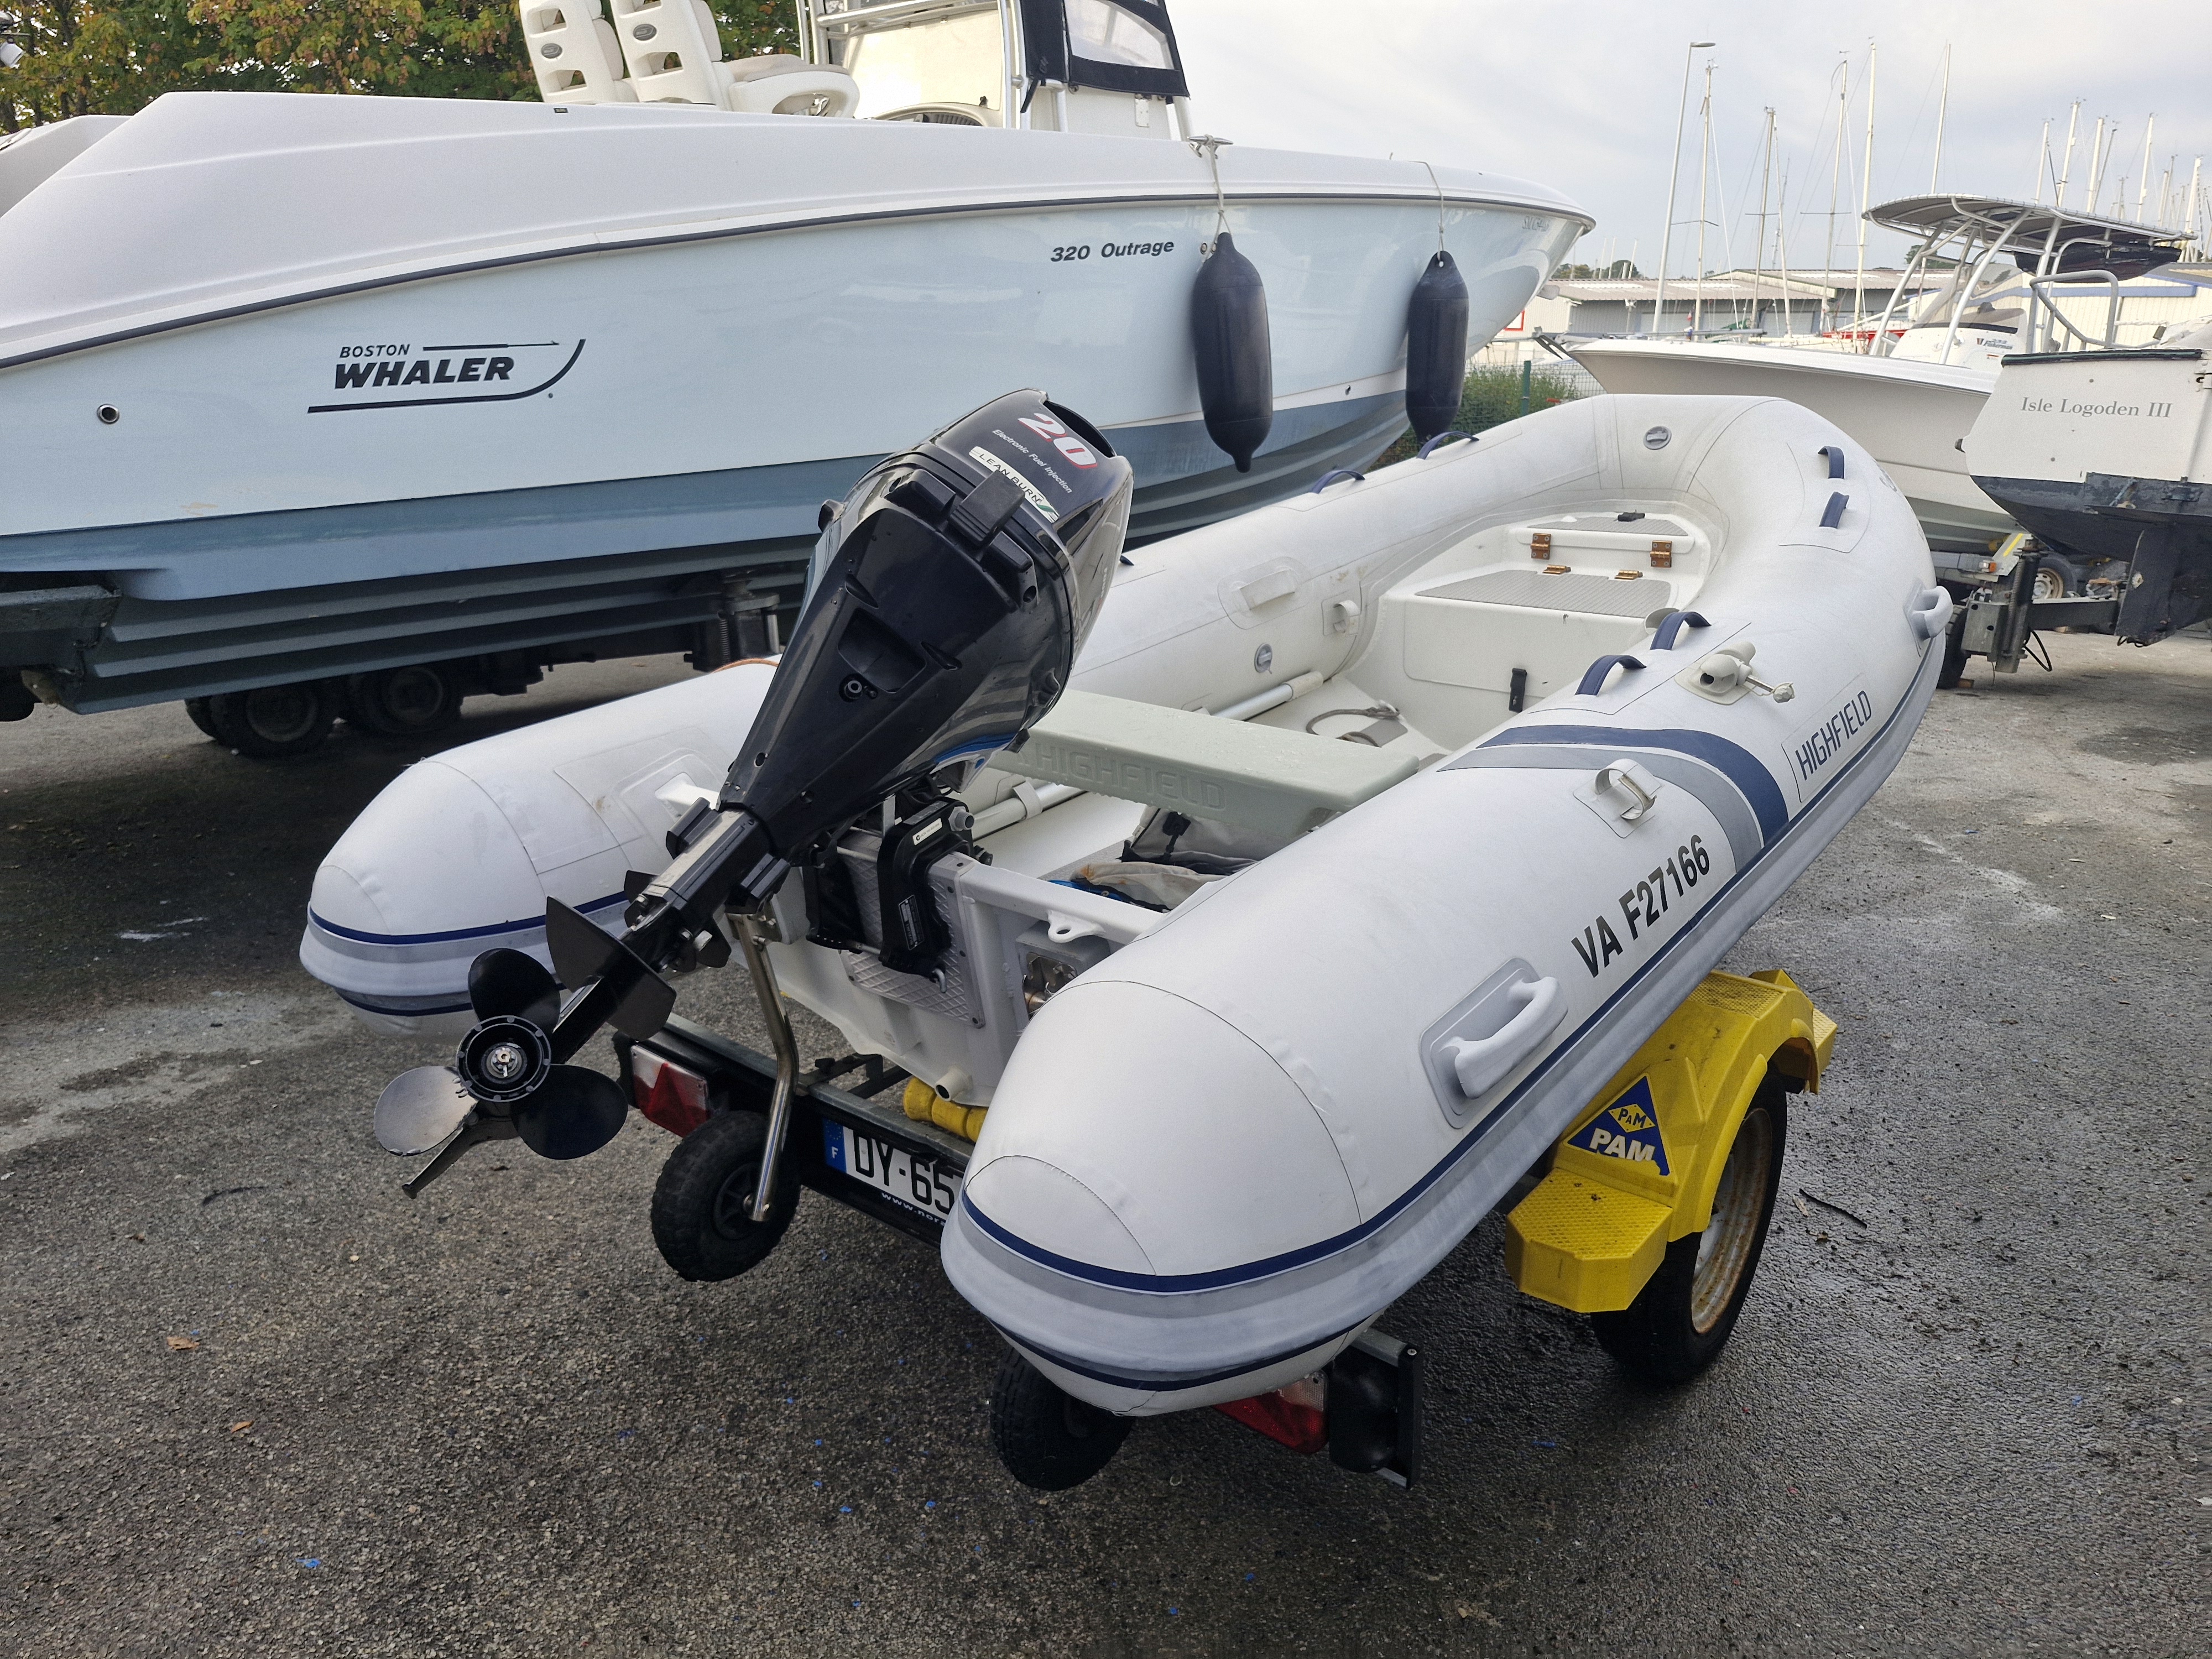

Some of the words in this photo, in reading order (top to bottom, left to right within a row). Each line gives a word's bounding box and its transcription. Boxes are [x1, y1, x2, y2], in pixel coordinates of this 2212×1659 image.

[1050, 245, 1091, 262] 320
[1100, 241, 1175, 258] Outrage
[339, 343, 411, 358] BOSTON
[333, 357, 515, 390] WHALER
[2020, 397, 2053, 412] Isle
[2059, 398, 2140, 418] Logoden
[2146, 402, 2173, 418] III
[1017, 412, 1098, 469] 20
[979, 453, 1010, 476] LEAN
[1010, 476, 1042, 504] BURN
[992, 429, 1030, 454] Electronic
[1028, 453, 1047, 467] Fuel
[1044, 466, 1073, 493] Injection
[1795, 690, 1872, 781] HIGHFIELD
[1035, 742, 1227, 812] HIGHFIELD
[1571, 915, 1624, 979] VA
[1618, 834, 1710, 941] F27166
[1617, 1108, 1647, 1128] PAM
[832, 1146, 839, 1159] F
[1589, 1127, 1656, 1162] PAM
